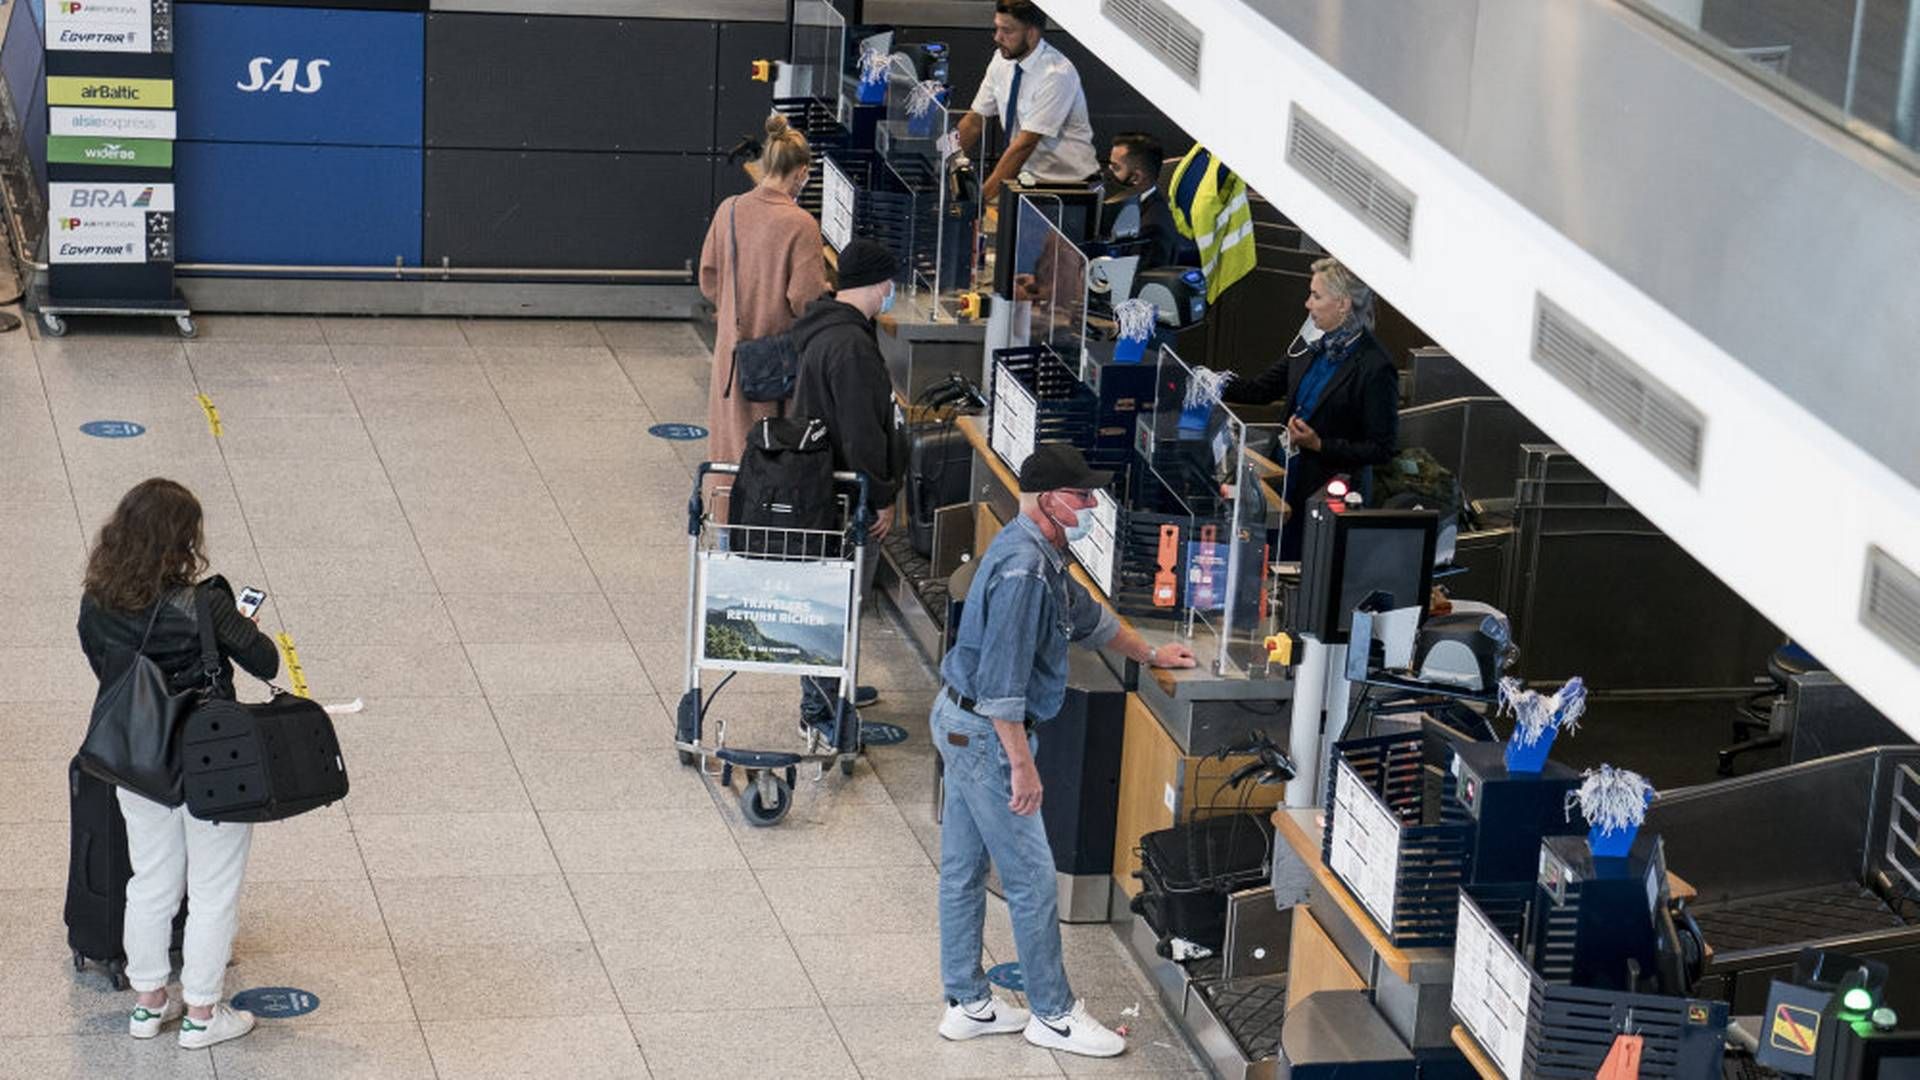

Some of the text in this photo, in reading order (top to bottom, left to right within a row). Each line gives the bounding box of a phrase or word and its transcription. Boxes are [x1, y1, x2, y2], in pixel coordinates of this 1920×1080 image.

[237, 57, 331, 93] SAS
[81, 85, 140, 99] airBaltic
[70, 189, 128, 208] BRA
[726, 608, 824, 627] RETURN RICHER
